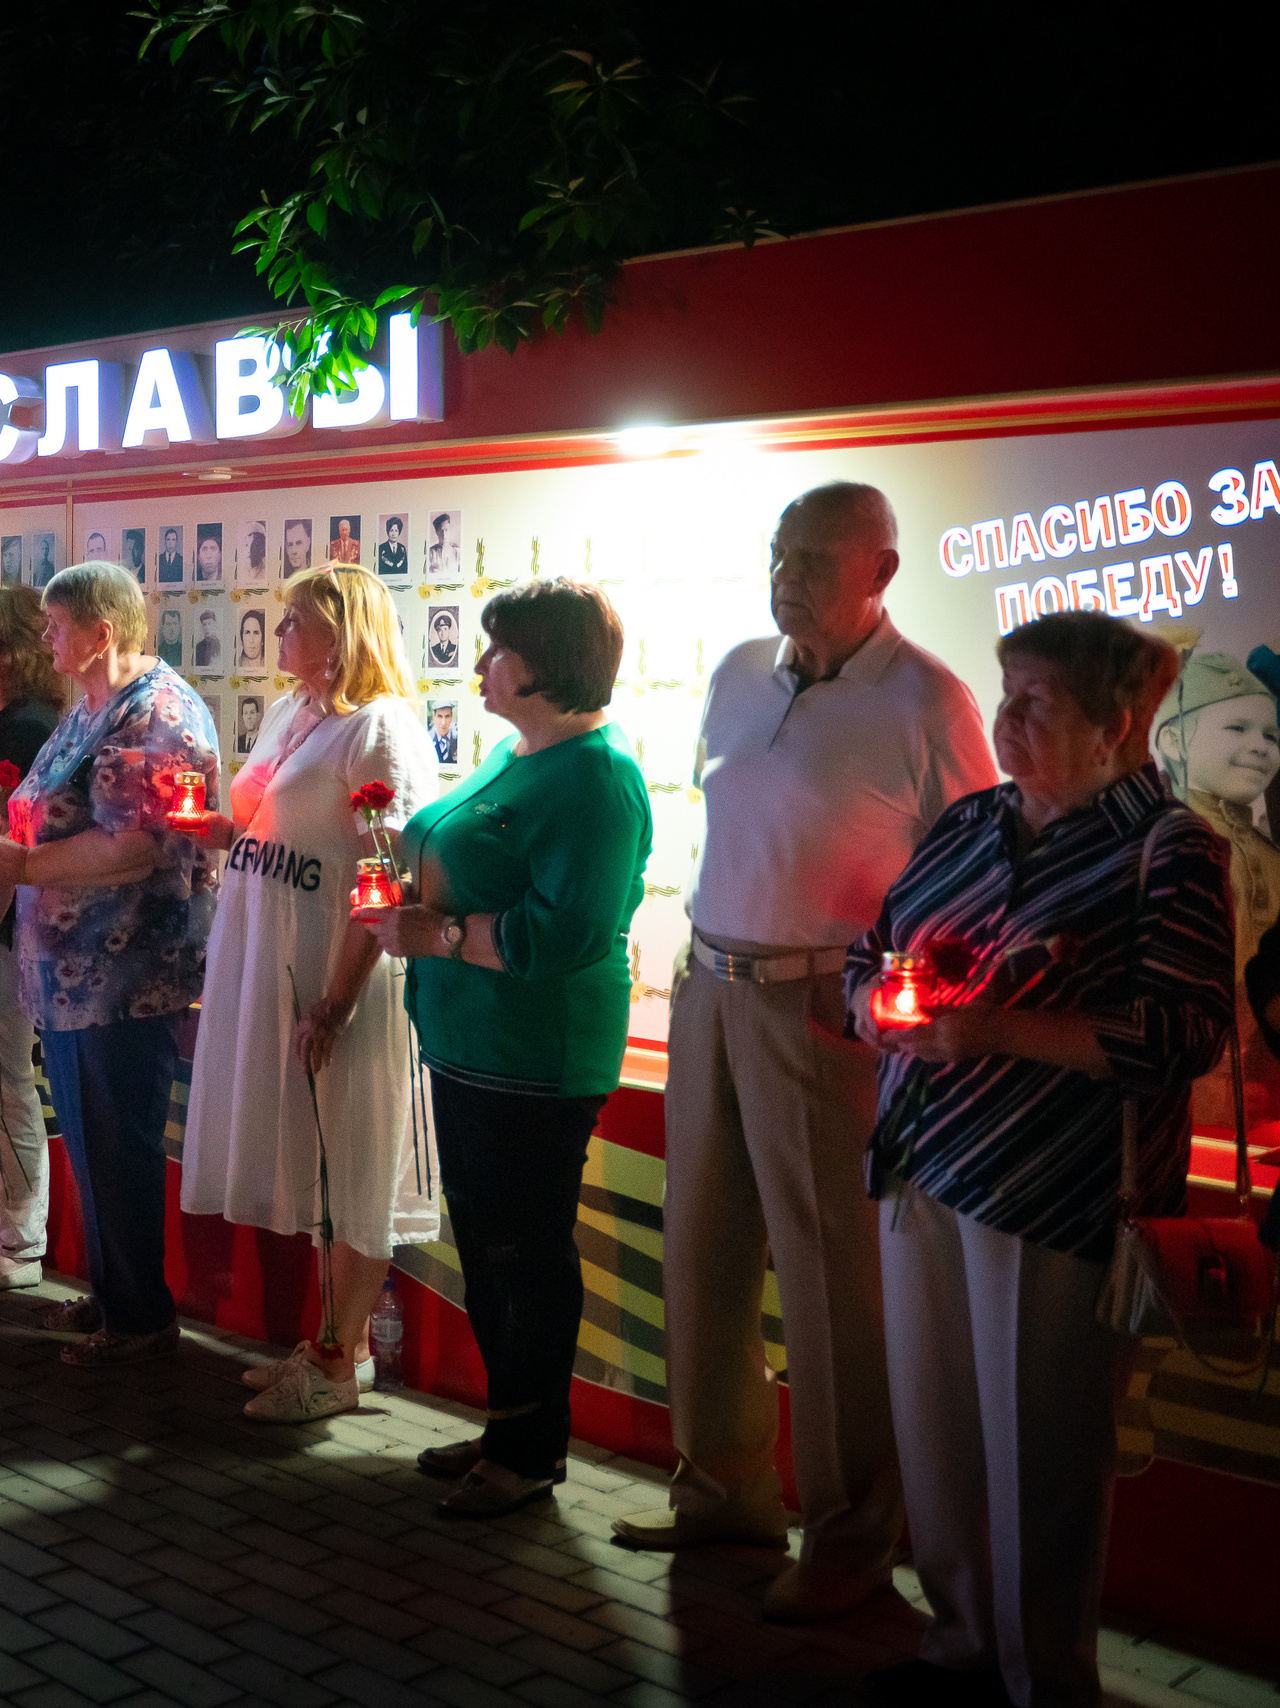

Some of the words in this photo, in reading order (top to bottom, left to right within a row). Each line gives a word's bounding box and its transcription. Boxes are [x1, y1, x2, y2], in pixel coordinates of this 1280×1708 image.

[939, 480, 1193, 578] СПАСИБО
[1209, 460, 1280, 526] ЗА
[995, 542, 1239, 637] ПОБЕДУ!
[225, 838, 322, 891] ERWANG
